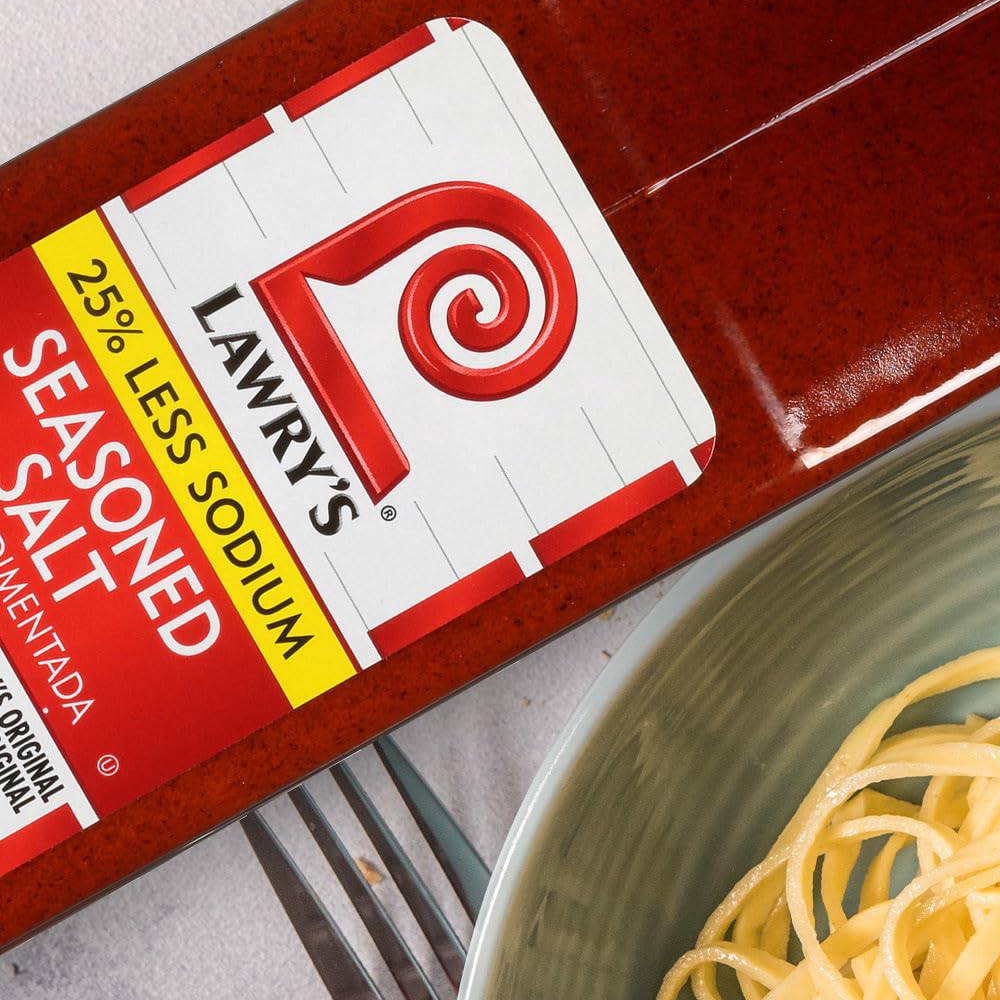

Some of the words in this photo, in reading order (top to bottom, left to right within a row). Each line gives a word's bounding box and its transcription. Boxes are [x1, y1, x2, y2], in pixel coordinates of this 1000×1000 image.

[2, 328, 222, 658] SEASONED
[67, 258, 144, 355] 25%
[124, 357, 207, 465] LESS
[187, 471, 314, 660] SODIUM
[190, 282, 361, 537] LAWRY'S
[0, 453, 118, 603] SALT
[0, 536, 95, 725] IMENTADA
[0, 709, 65, 804] ORIGINAL
[0, 736, 36, 815] GINAL
